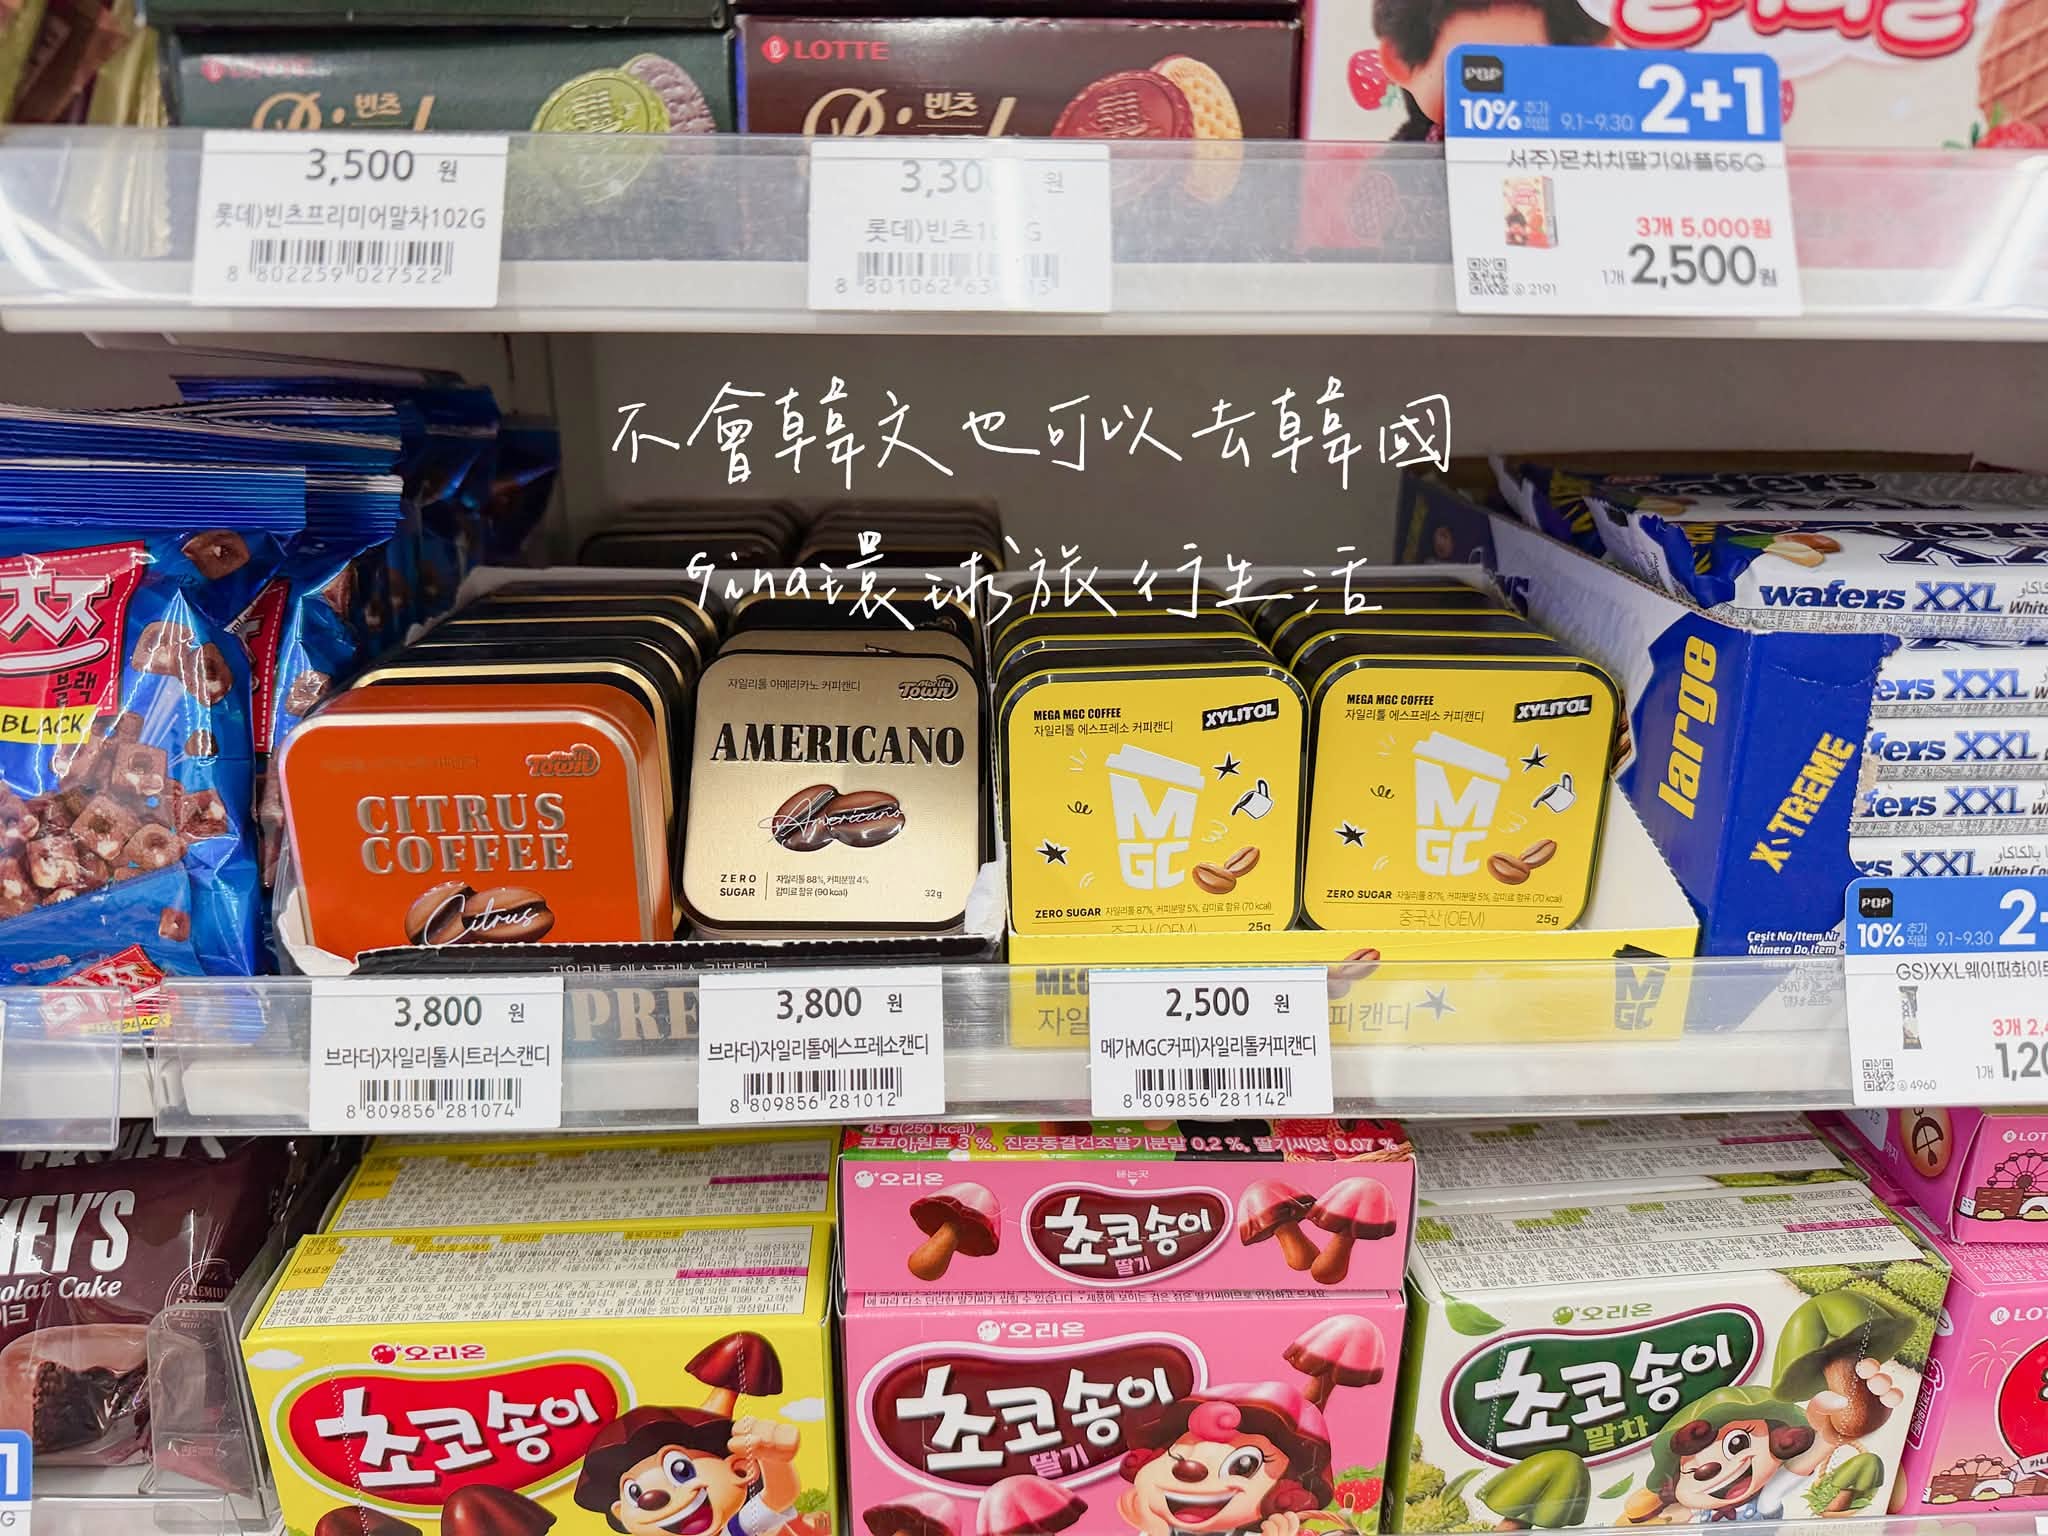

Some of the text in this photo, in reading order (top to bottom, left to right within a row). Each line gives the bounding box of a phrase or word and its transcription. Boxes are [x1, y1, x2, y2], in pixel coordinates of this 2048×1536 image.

[793, 40, 889, 60] LOTTE
[354, 91, 402, 119] 빈츠
[925, 91, 978, 119] 빈츠
[1638, 64, 1766, 136] 2+1
[1459, 98, 1522, 131] 10%
[305, 148, 458, 186] 3,500 원
[215, 202, 486, 230] 롯데)빈츠프리미어말차102G
[1636, 217, 1674, 237] 3개
[226, 266, 239, 283] 8
[356, 266, 443, 284] 027522
[1759, 580, 2003, 613] wafers XXL
[52, 672, 98, 706] 블랙
[1942, 668, 2029, 701] XXL
[1347, 694, 1435, 706] MEGA MGC COFFEE
[1516, 699, 1590, 720] XYLITOL
[2, 714, 85, 738] BLACK
[1034, 708, 1121, 721] MEGA MGC COFFEE
[1205, 704, 1277, 727] XYLITOL
[1389, 710, 1440, 721] 에스프레소
[1443, 711, 1484, 723] 커피캔디
[1078, 722, 1129, 735] 에스프레소
[1132, 720, 1174, 734] 커피캔디
[1657, 635, 1718, 820] large
[710, 722, 965, 766] AMERICANO
[1952, 730, 2039, 762] XXL
[1943, 785, 2025, 818] XXL
[355, 792, 567, 836] CITRUS
[360, 833, 573, 876] COFFEE
[1415, 830, 1488, 876] GC
[1901, 849, 1984, 876] XXL
[1118, 841, 1190, 890] GC
[720, 874, 757, 884] ZERO
[719, 887, 756, 898] SUGAR
[924, 889, 943, 900] 32g
[1326, 889, 1393, 900] ZERO SUGAR
[1861, 897, 1891, 909] POP
[422, 892, 540, 946] Citrus
[1035, 908, 1064, 919] ZERO
[1066, 906, 1101, 918] SUGAR
[1536, 914, 1559, 926] 25g
[1248, 922, 1271, 932] 25g
[1777, 931, 1823, 943] No/Item
[1825, 931, 1840, 942] Nr
[1857, 923, 1905, 948] 10%
[1748, 944, 1792, 955] Número
[394, 996, 525, 1031] 3,800 원
[776, 986, 903, 1024] 3,800 원
[1165, 986, 1290, 1022] 2,500 원
[1992, 1018, 2021, 1037] 3개
[324, 1045, 550, 1069] 브라더)자일리톨시트러스캔디
[707, 1034, 929, 1062] 브라더)자일리톨에스프레소캔디
[1100, 1034, 1316, 1058] 메가MGC커피)자일리톨커피캔디
[1976, 1066, 1995, 1079] 1개
[1910, 1080, 1937, 1091] 4960
[346, 1104, 515, 1119] 8 809856 281074
[730, 1092, 896, 1113] 8 809856 281012
[1123, 1092, 1286, 1108] 8 809856 281142
[864, 1122, 976, 1135] 45 g(250 kcal)
[860, 1136, 951, 1151] 코코아원료
[959, 1136, 970, 1149] 3
[1190, 1137, 1223, 1151] 0.2
[1254, 1136, 1328, 1151] 딸기씨앗
[1334, 1138, 1373, 1151] 0.07
[880, 1172, 944, 1186] 오리온
[1045, 1195, 1214, 1267] 초코송이
[1114, 1256, 1151, 1276] 딸기
[58, 1275, 122, 1299] Cake
[1581, 1302, 1653, 1320] 오리온
[1008, 1321, 1085, 1338] 오리온
[404, 1345, 486, 1361] 오리온
[1475, 1334, 1733, 1447] 초코송이
[896, 1364, 1176, 1472] 초코송이
[316, 1386, 600, 1488] 초코송이
[1583, 1416, 1650, 1448] 말차
[1030, 1443, 1089, 1479] 딸기
